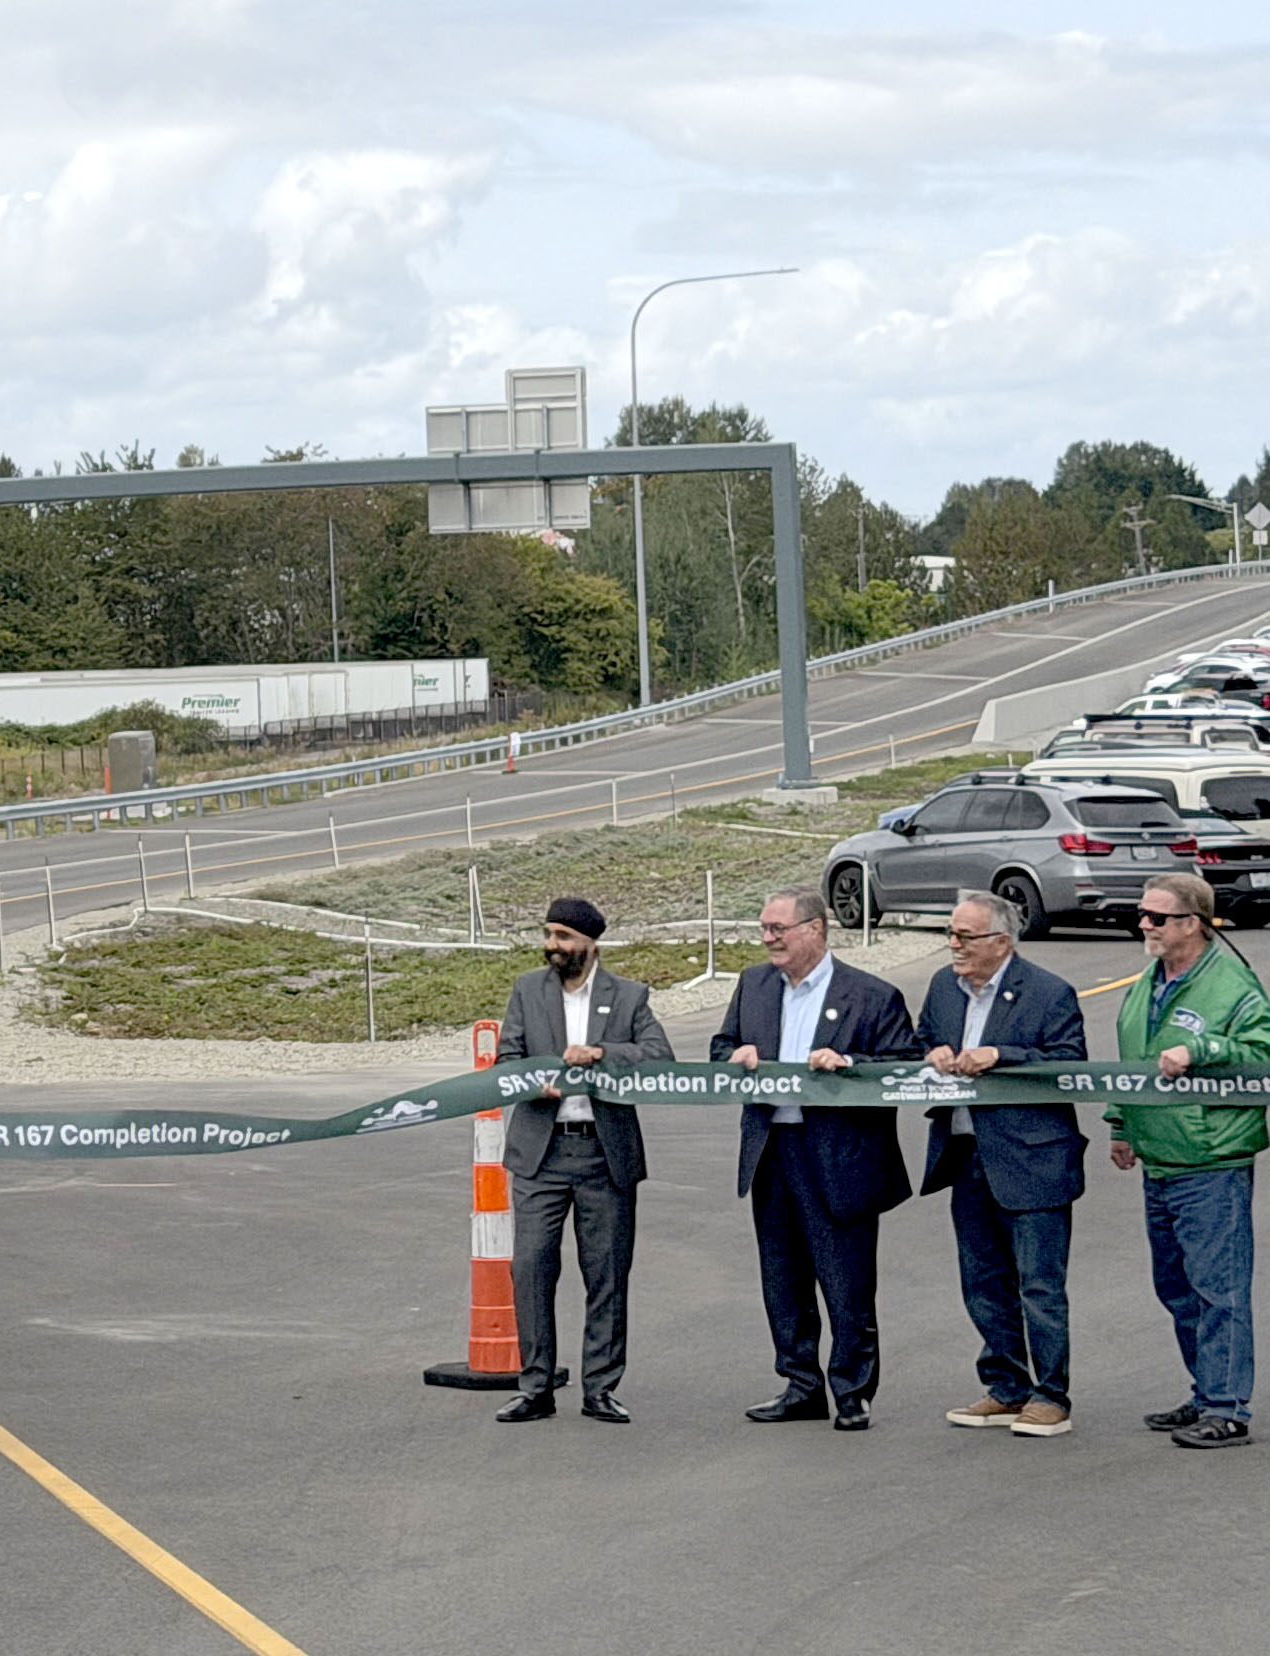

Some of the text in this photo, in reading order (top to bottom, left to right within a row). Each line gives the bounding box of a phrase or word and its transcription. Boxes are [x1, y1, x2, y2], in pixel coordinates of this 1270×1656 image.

[181, 695, 241, 710] Premier
[498, 1074, 529, 1097] SR
[565, 1066, 708, 1097] Completion
[713, 1072, 803, 1096] Project
[1057, 1073, 1096, 1092] SR
[1101, 1074, 1147, 1092] 167
[14, 1125, 54, 1147] 167
[60, 1123, 197, 1149] Completion
[202, 1123, 291, 1147] Project
